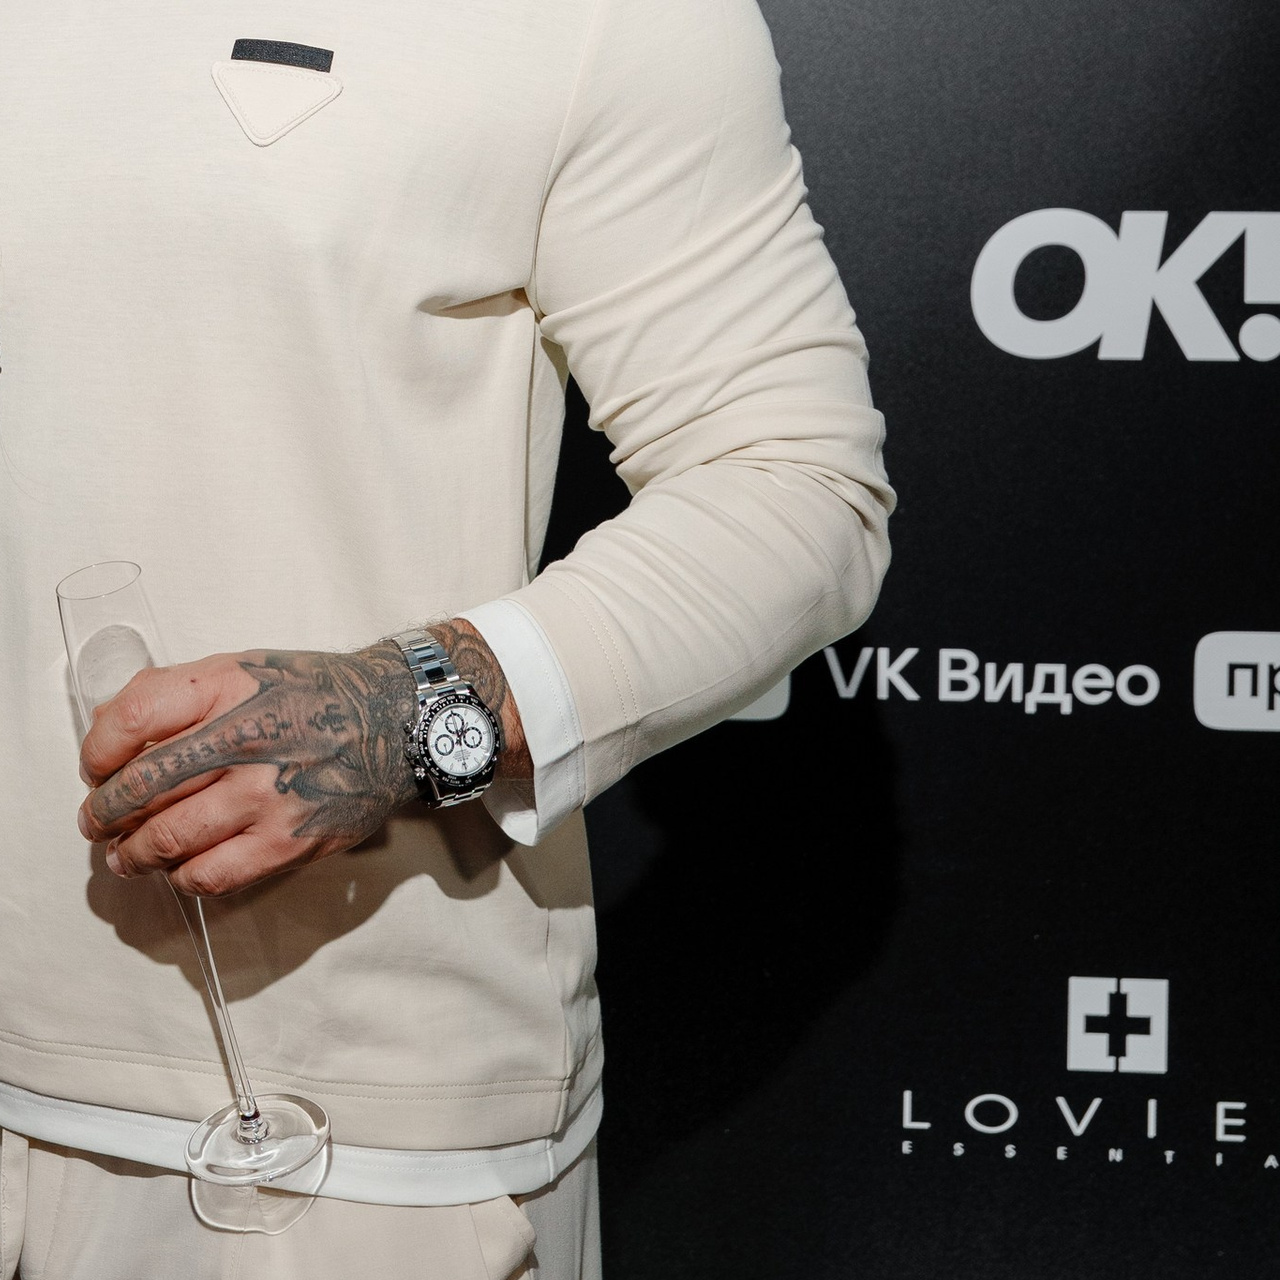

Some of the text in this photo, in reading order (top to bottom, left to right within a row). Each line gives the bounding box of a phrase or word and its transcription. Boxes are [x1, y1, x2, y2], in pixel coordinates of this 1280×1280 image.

[970, 207, 1280, 362] OK!
[823, 646, 1160, 715] VK Видео
[901, 1089, 1247, 1143] LOVIE
[901, 1139, 1280, 1170] ESSENTIA
